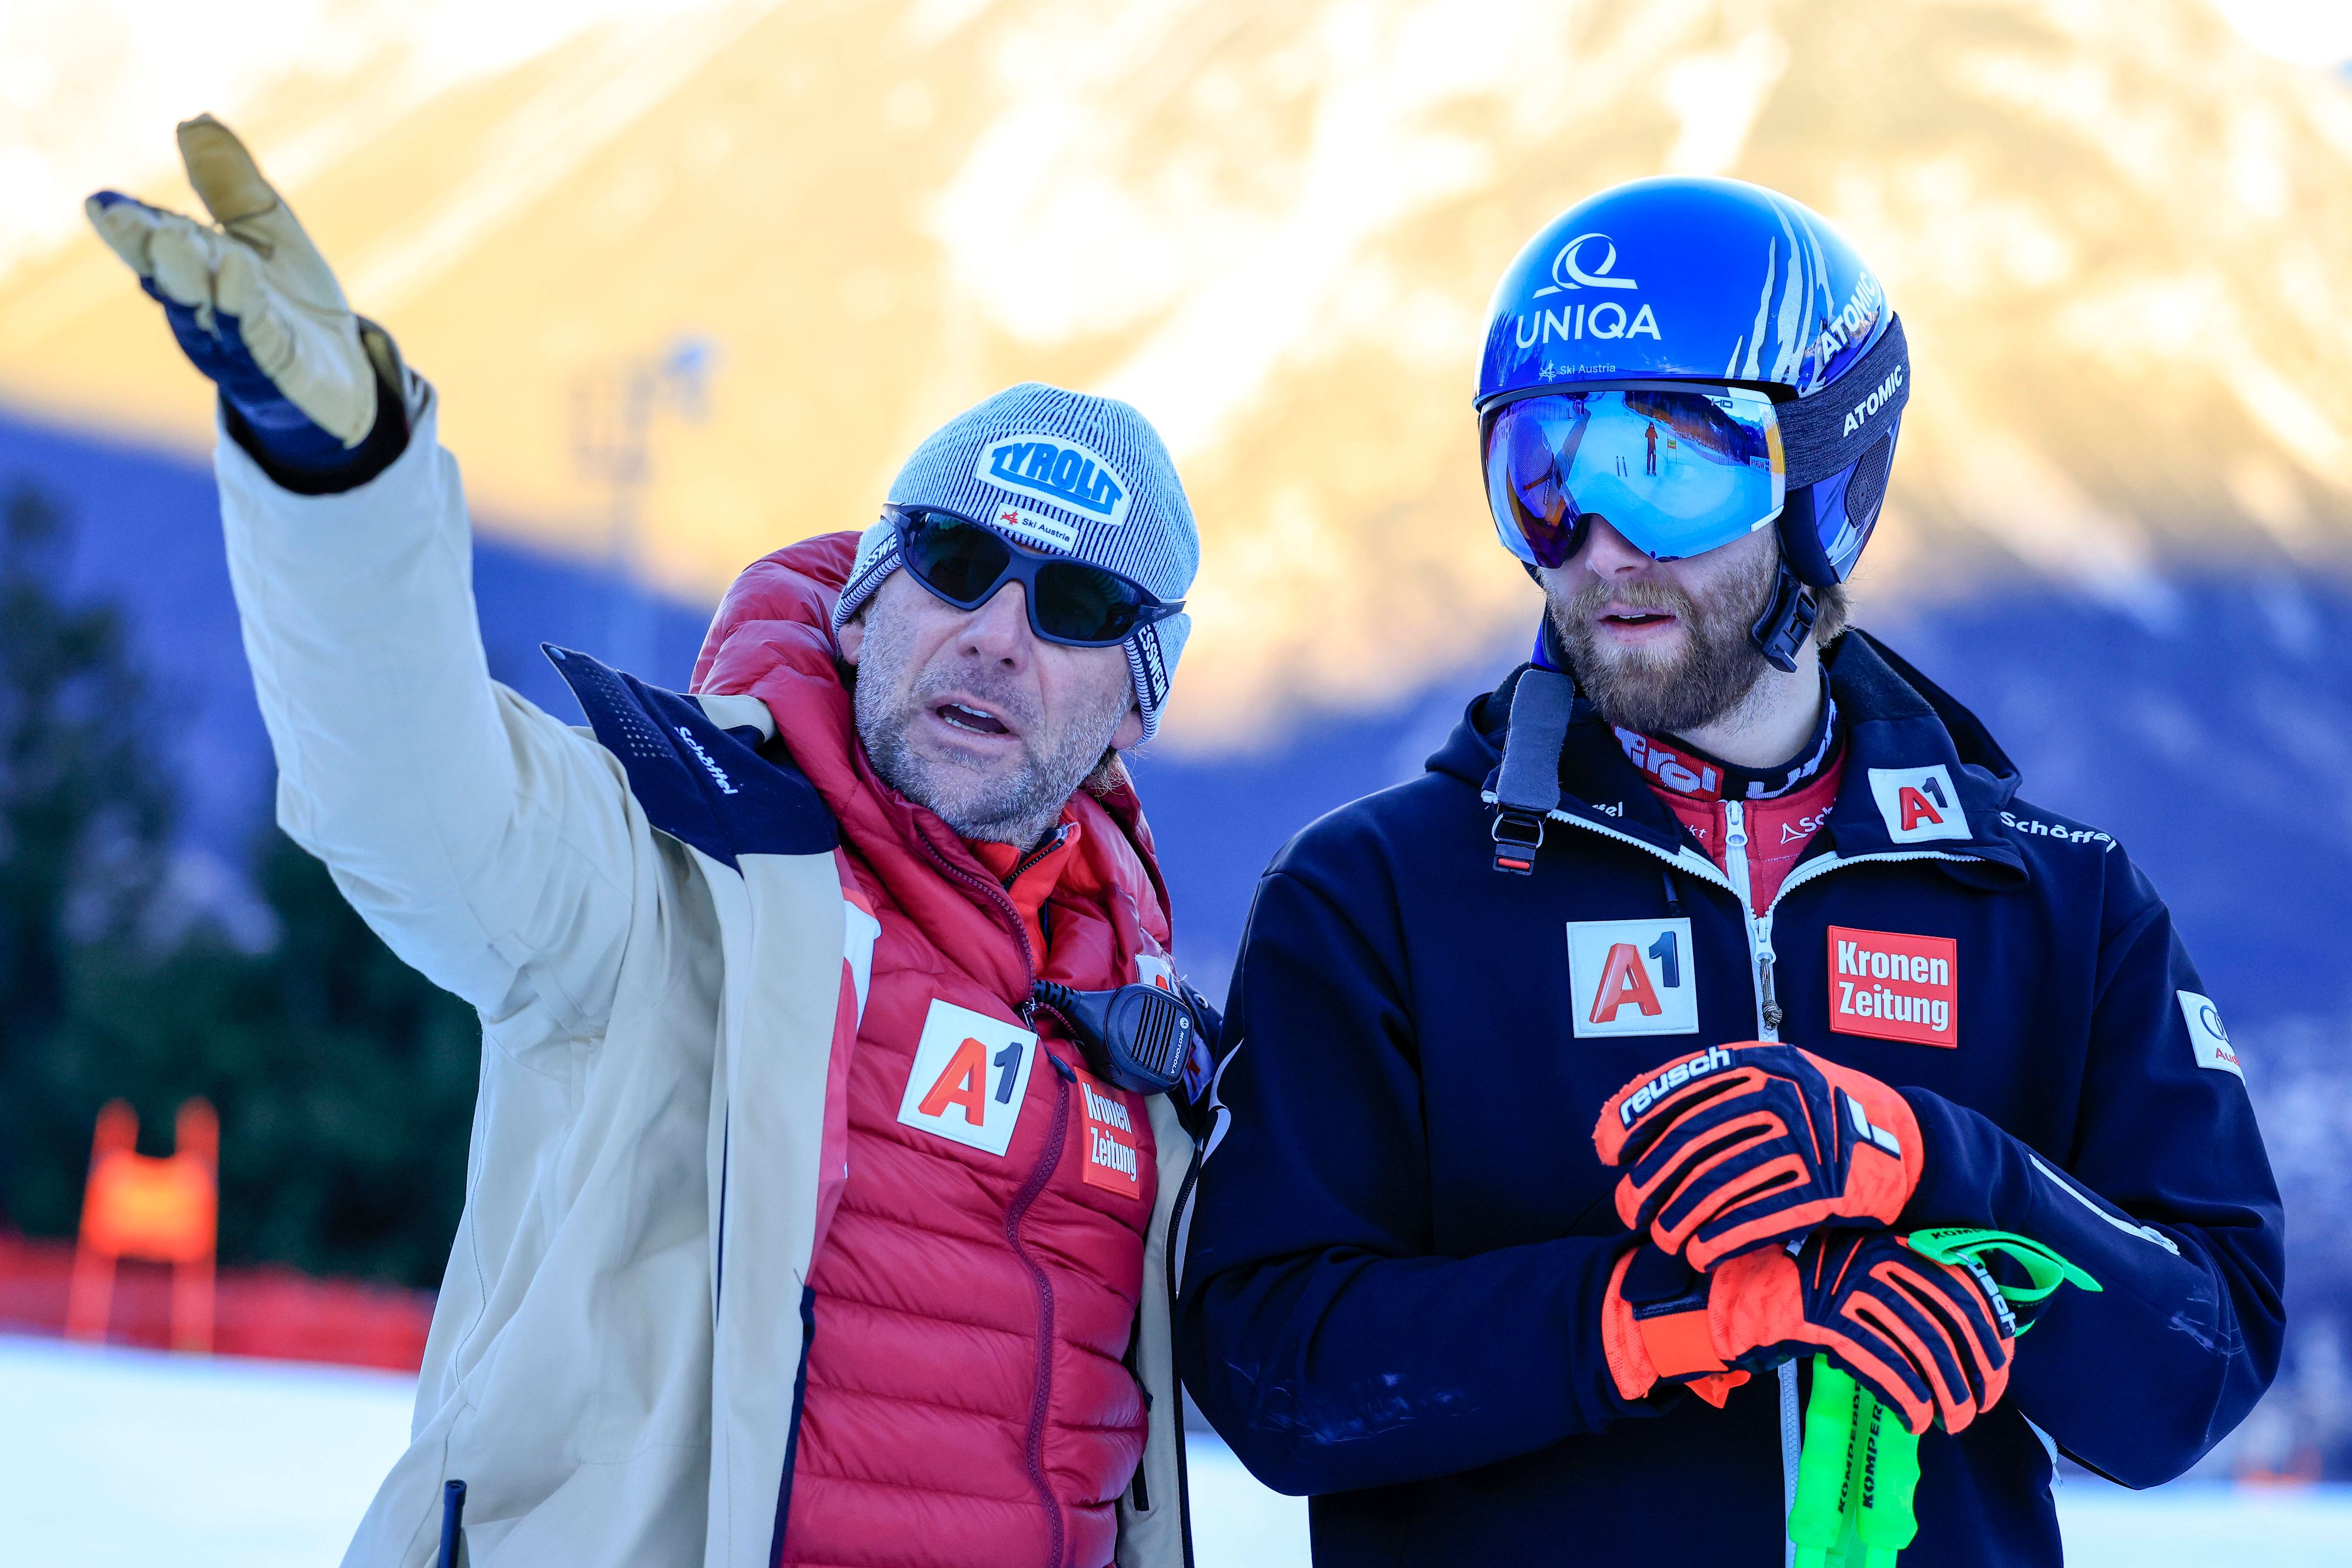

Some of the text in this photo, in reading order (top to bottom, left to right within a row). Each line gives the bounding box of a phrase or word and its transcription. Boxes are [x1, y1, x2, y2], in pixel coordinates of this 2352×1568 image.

[1515, 302, 1662, 349] UNIQA
[1821, 271, 1876, 365] ATOMIC
[1560, 363, 1616, 375] Ski Austria
[1843, 365, 1903, 438] ATOMIC
[990, 442, 1123, 507] TYROLIT
[1022, 518, 1070, 542] Ski Austria
[1138, 624, 1167, 702] ESSWEIN
[1899, 777, 1948, 831] A1
[1589, 931, 1680, 1024] A1
[1838, 940, 1949, 986] Kronen
[1839, 981, 1949, 1032] Zeitung
[918, 1037, 1023, 1126] A1
[1170, 1031, 1185, 1075] MOTOROLA
[1082, 1082, 1132, 1134] Kronen
[1620, 1046, 1730, 1125] reusch
[1090, 1126, 1137, 1182] Zeitung
[1838, 1382, 1861, 1514] KOMPERDE
[1863, 1404, 1883, 1509] KOMPER
